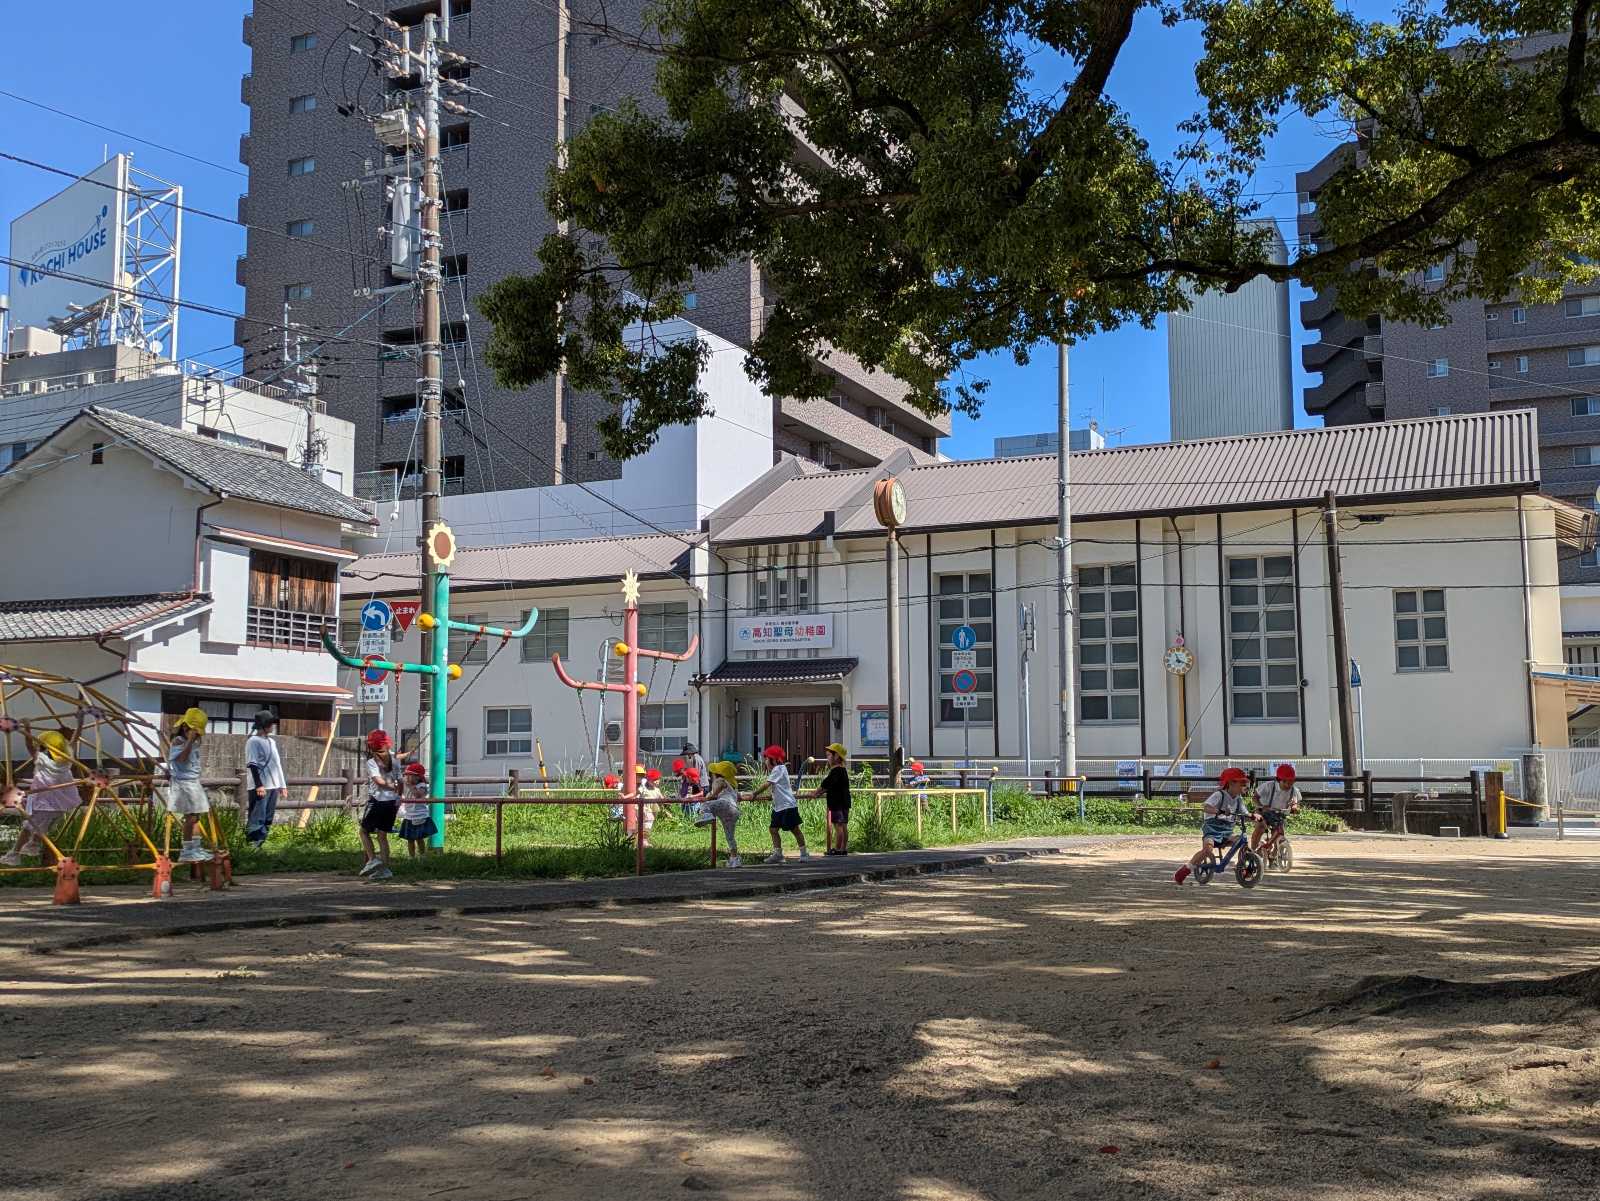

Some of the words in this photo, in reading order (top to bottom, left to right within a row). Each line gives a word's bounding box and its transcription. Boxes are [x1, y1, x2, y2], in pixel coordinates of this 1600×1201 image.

[30, 253, 65, 285] KOCHI
[68, 228, 106, 264] HOUSE
[395, 606, 416, 615] 止まれ
[752, 625, 826, 638] 高知聖母幼稚園
